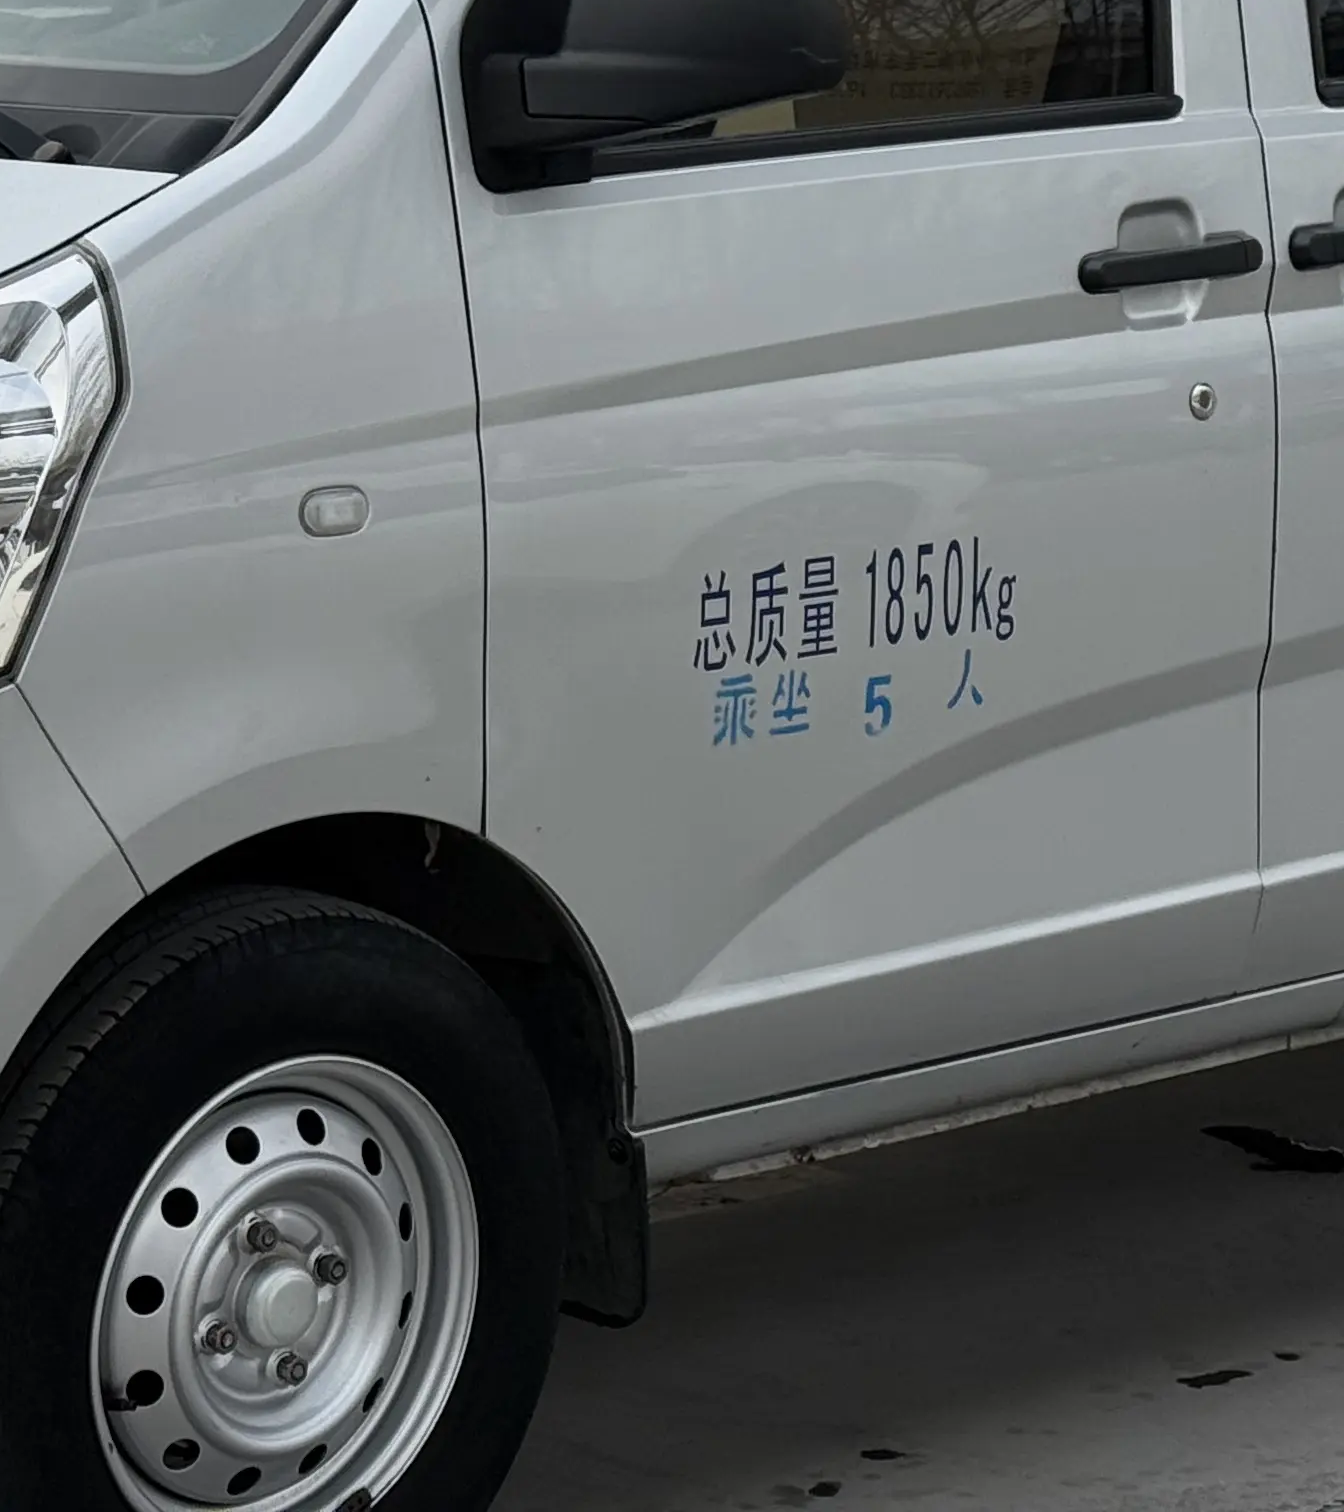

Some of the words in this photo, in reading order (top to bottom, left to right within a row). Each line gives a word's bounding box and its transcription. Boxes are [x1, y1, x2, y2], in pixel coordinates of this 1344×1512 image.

[692, 555, 839, 672] 总质量
[865, 536, 1017, 648] 1850kg
[864, 674, 893, 737] 5
[947, 648, 984, 710] 人
